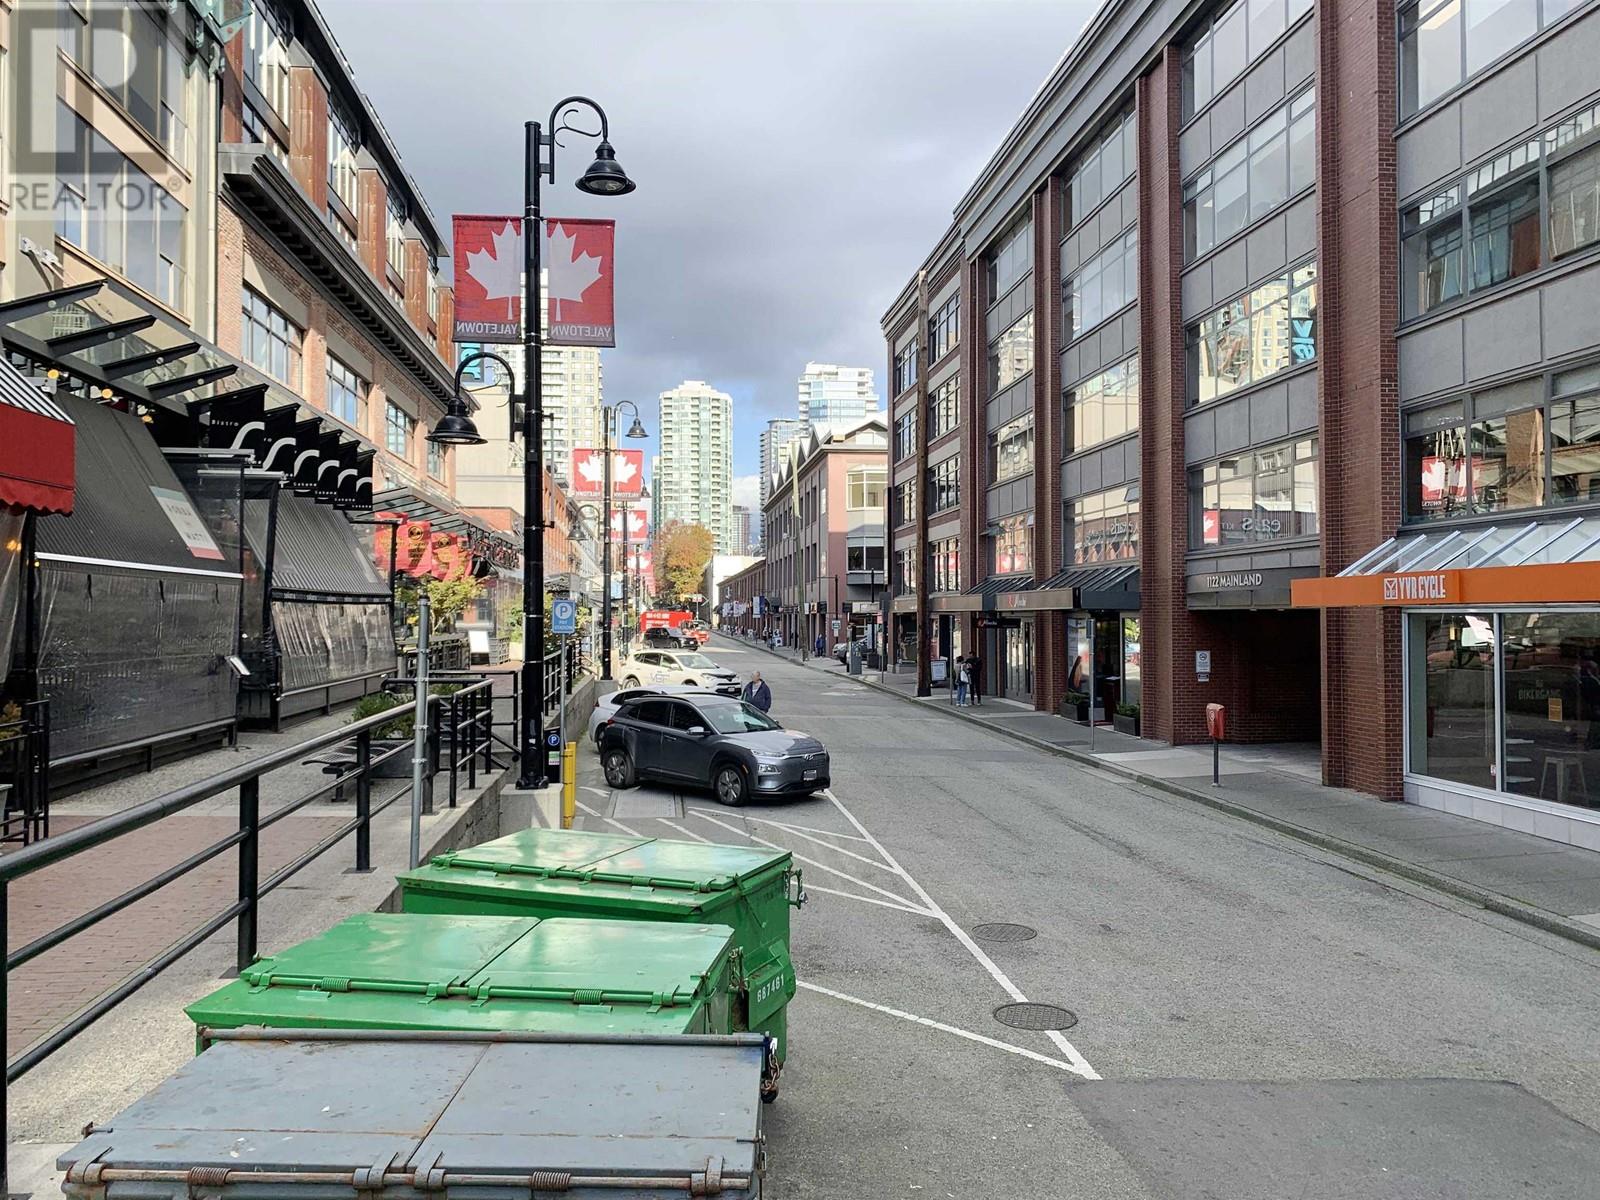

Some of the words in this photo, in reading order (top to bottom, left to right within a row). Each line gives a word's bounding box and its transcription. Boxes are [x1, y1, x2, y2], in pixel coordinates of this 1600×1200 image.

[1206, 575, 1219, 588] 1122
[1220, 573, 1263, 587] MAINLAND
[1398, 576, 1418, 599] YVR
[1418, 574, 1446, 599] CYCLE
